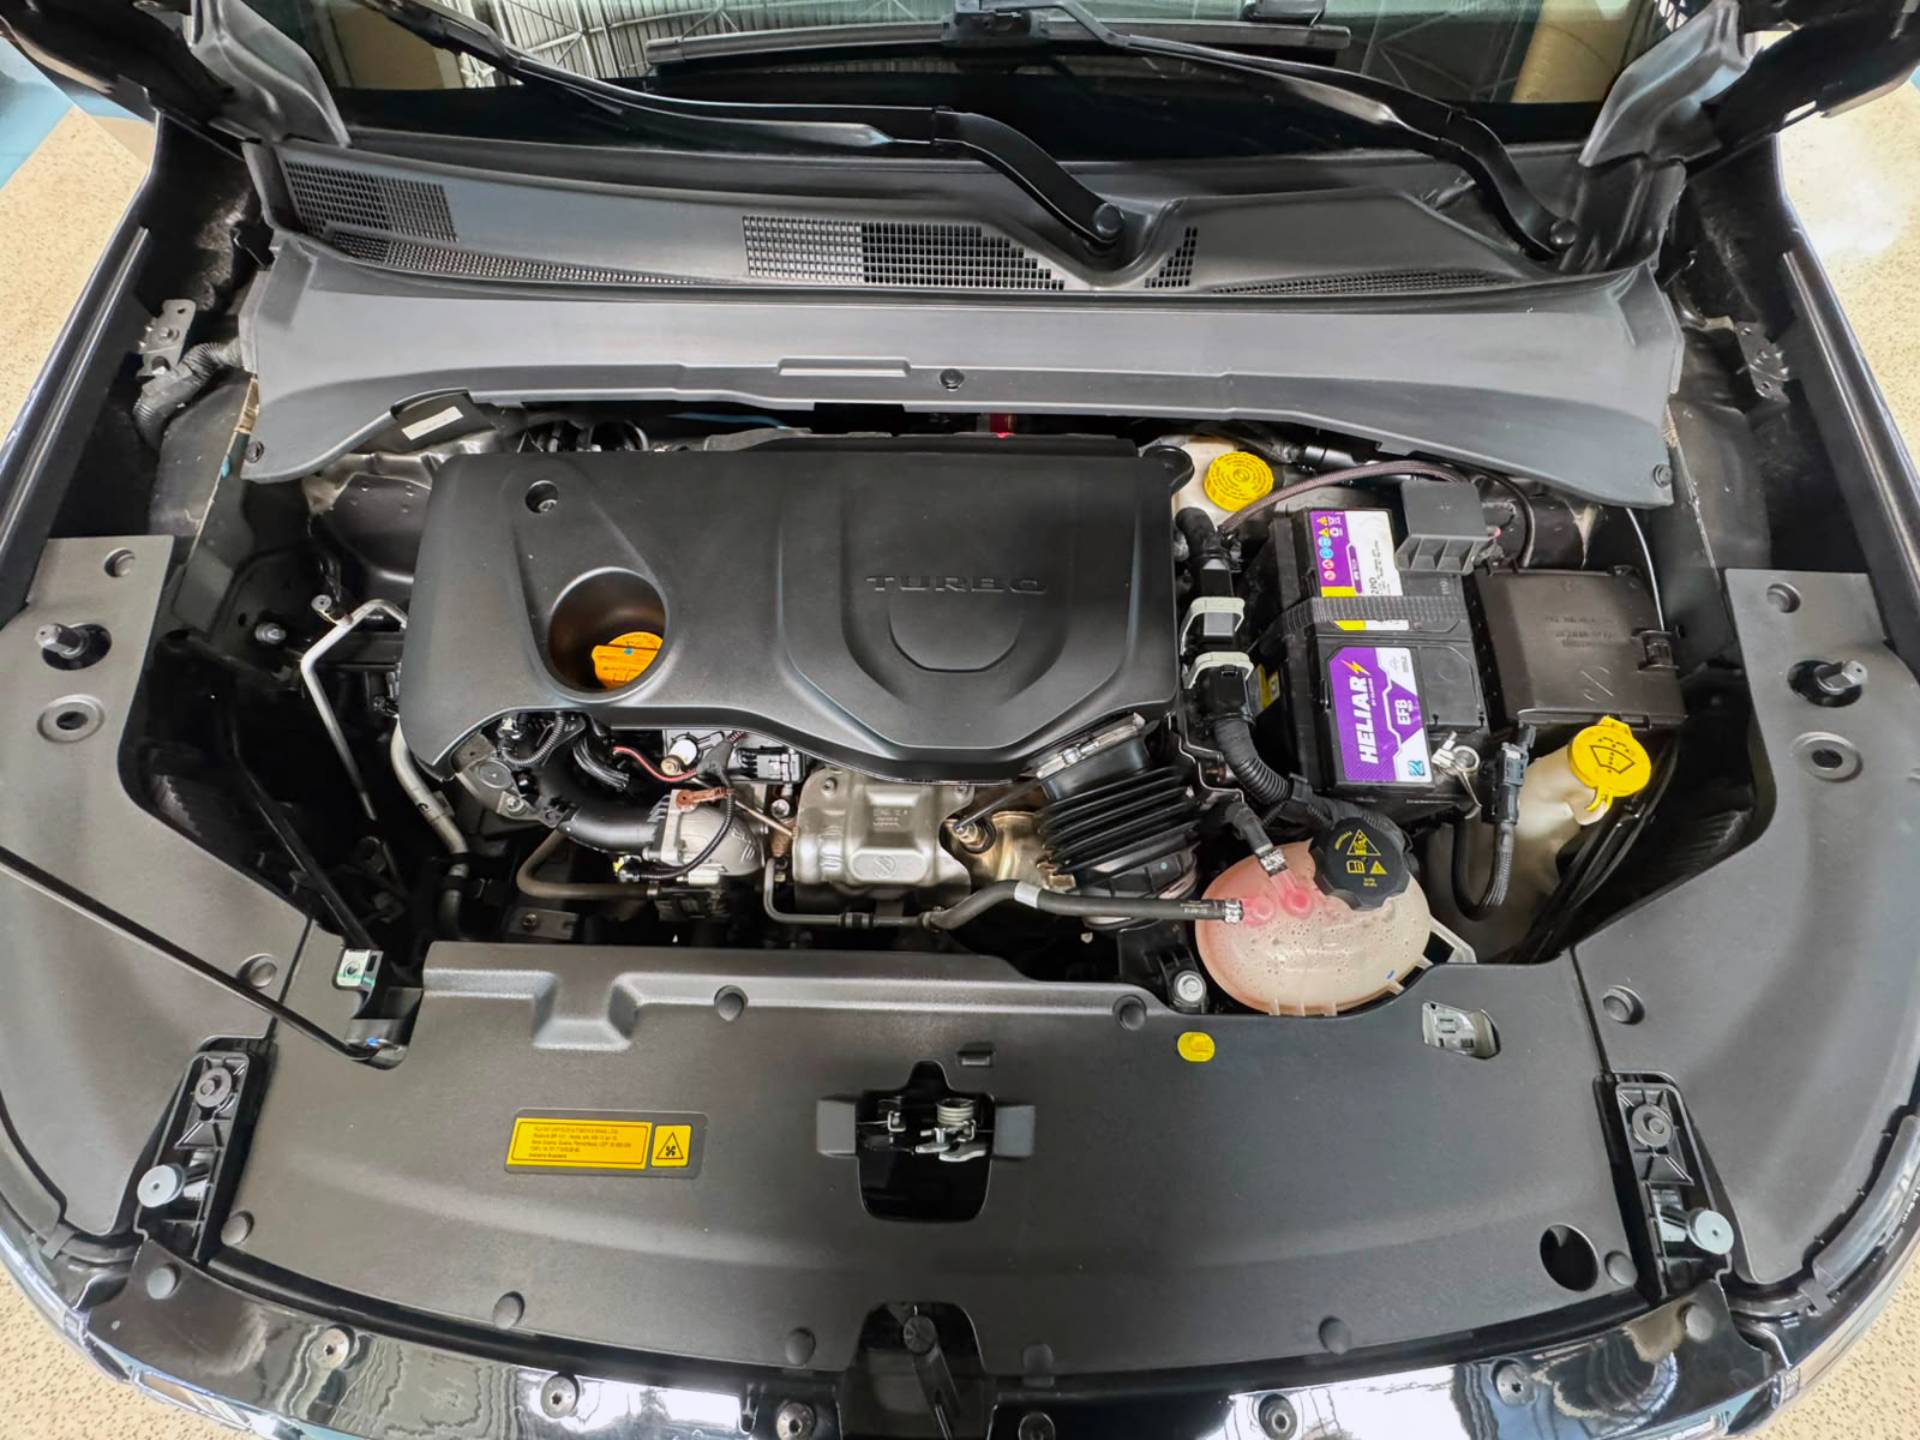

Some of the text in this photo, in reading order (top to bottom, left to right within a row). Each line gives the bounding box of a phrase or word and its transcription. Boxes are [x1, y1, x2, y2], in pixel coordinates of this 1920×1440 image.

[867, 576, 1046, 595] TURBO
[1349, 676, 1379, 764] HELIAR
[1395, 699, 1412, 725] EFB
